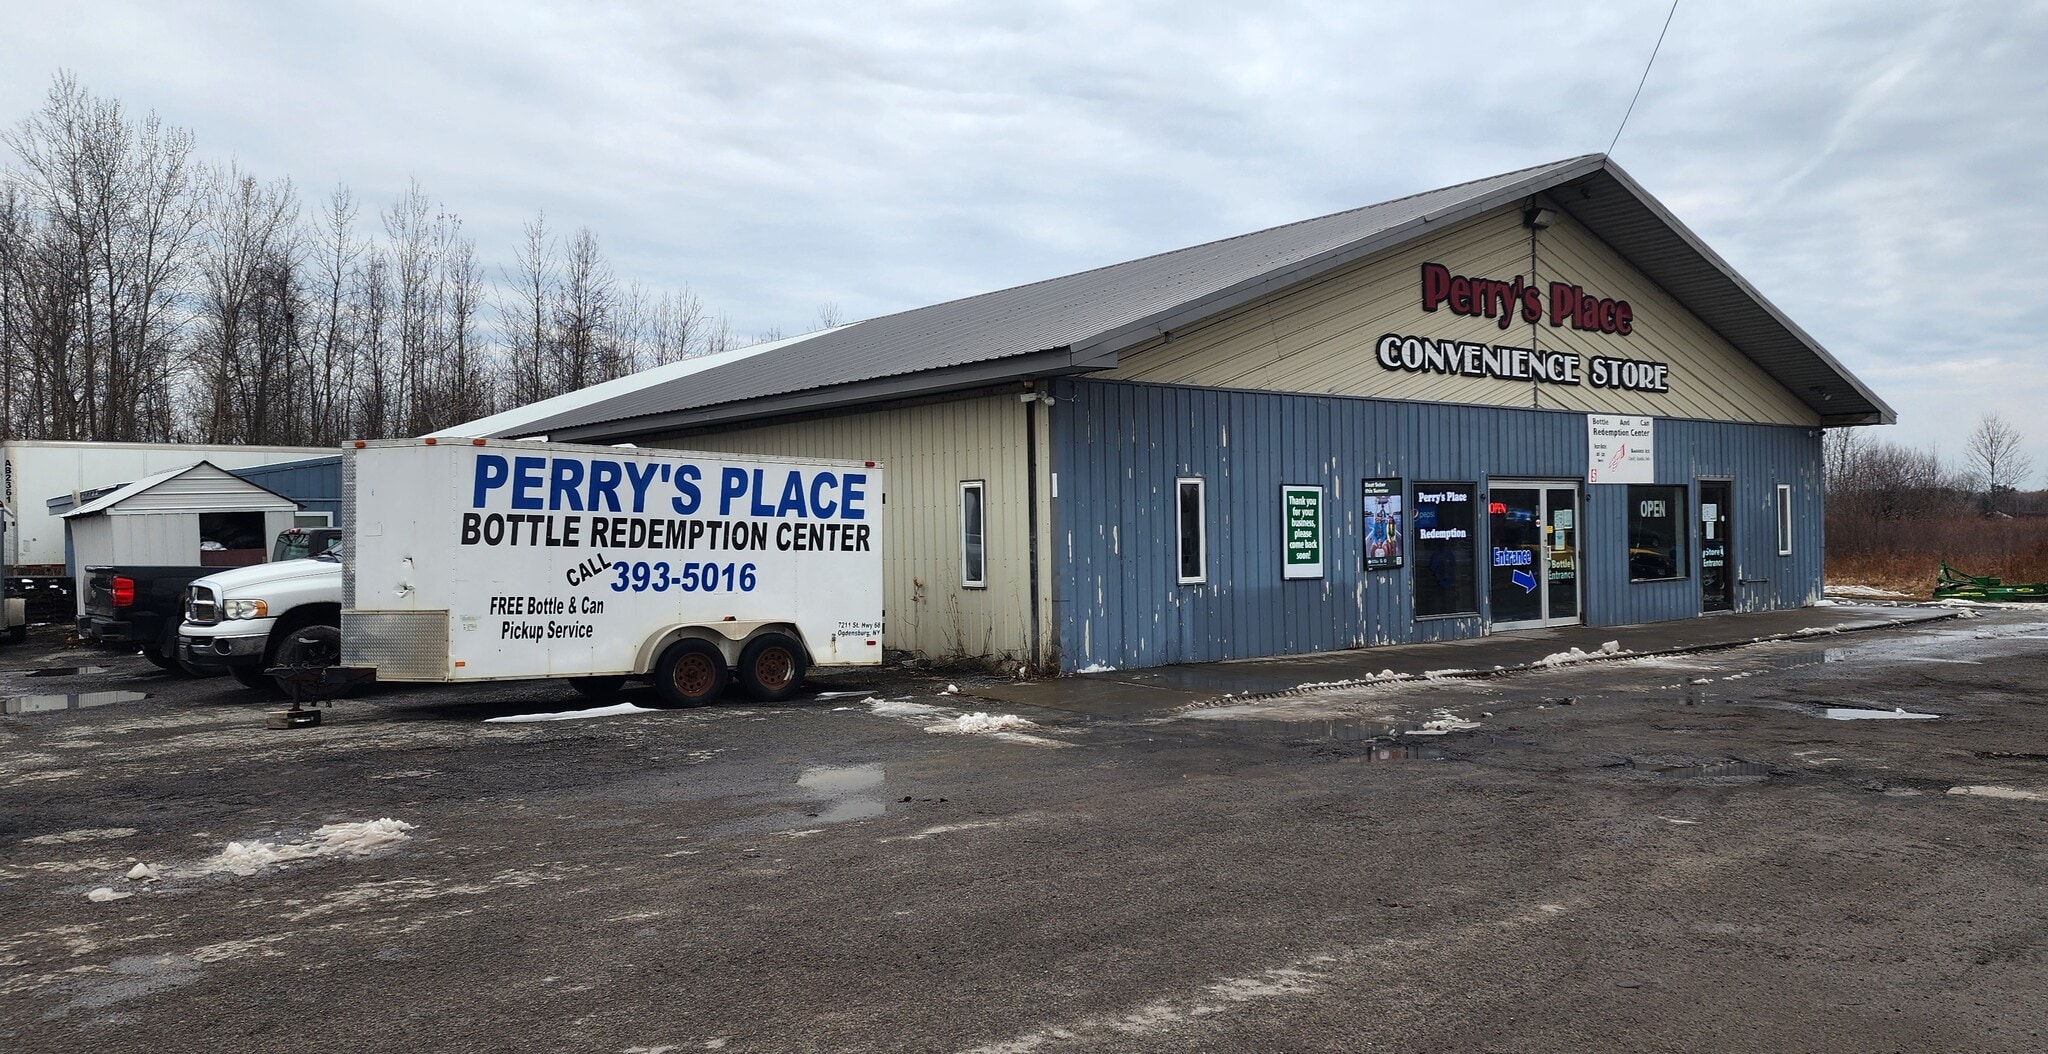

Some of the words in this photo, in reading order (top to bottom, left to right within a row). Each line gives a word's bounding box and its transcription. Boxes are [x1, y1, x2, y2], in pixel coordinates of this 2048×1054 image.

[1421, 262, 1542, 329] Perry's
[1550, 281, 1633, 336] Place
[1376, 333, 1580, 385] CONVENIENCE
[1590, 355, 1668, 393] STORE
[1592, 418, 1609, 426] Bottle
[1640, 419, 1650, 427] Can
[1593, 428, 1629, 438] Redemption
[1630, 429, 1650, 437] Center
[472, 454, 702, 515] PERRY'S
[719, 467, 867, 520] PLACE
[1289, 496, 1306, 506] Thank
[1306, 498, 1316, 508] you
[1418, 492, 1445, 504] Perry's
[1446, 491, 1467, 502] Place
[1292, 507, 1301, 516] for
[1301, 508, 1315, 519] your
[1488, 503, 1507, 514] OPEN
[1640, 500, 1666, 518] OPEN
[1420, 511, 1435, 519] pepsi
[1291, 518, 1316, 528] business,
[461, 513, 581, 547] BOTTLE
[590, 517, 768, 551] REDEMPTION
[776, 522, 871, 552] CENTER
[1294, 529, 1312, 540] please
[1420, 528, 1467, 540] Redemption
[1289, 541, 1305, 549] come
[1304, 540, 1318, 549] back
[1296, 550, 1311, 560] soon!
[1493, 547, 1531, 566] Entrance
[1706, 547, 1720, 556] Store
[1551, 559, 1571, 569] Bottle
[1703, 559, 1723, 567] Entrance
[566, 553, 612, 586] CALL
[1548, 570, 1575, 580] Entrance
[610, 561, 757, 593] 393-5016
[490, 596, 523, 615] FREE
[527, 596, 564, 615] Bottle
[568, 596, 577, 614] &
[581, 596, 604, 614] Can
[501, 621, 543, 643] Pickup
[547, 620, 593, 639] Service
